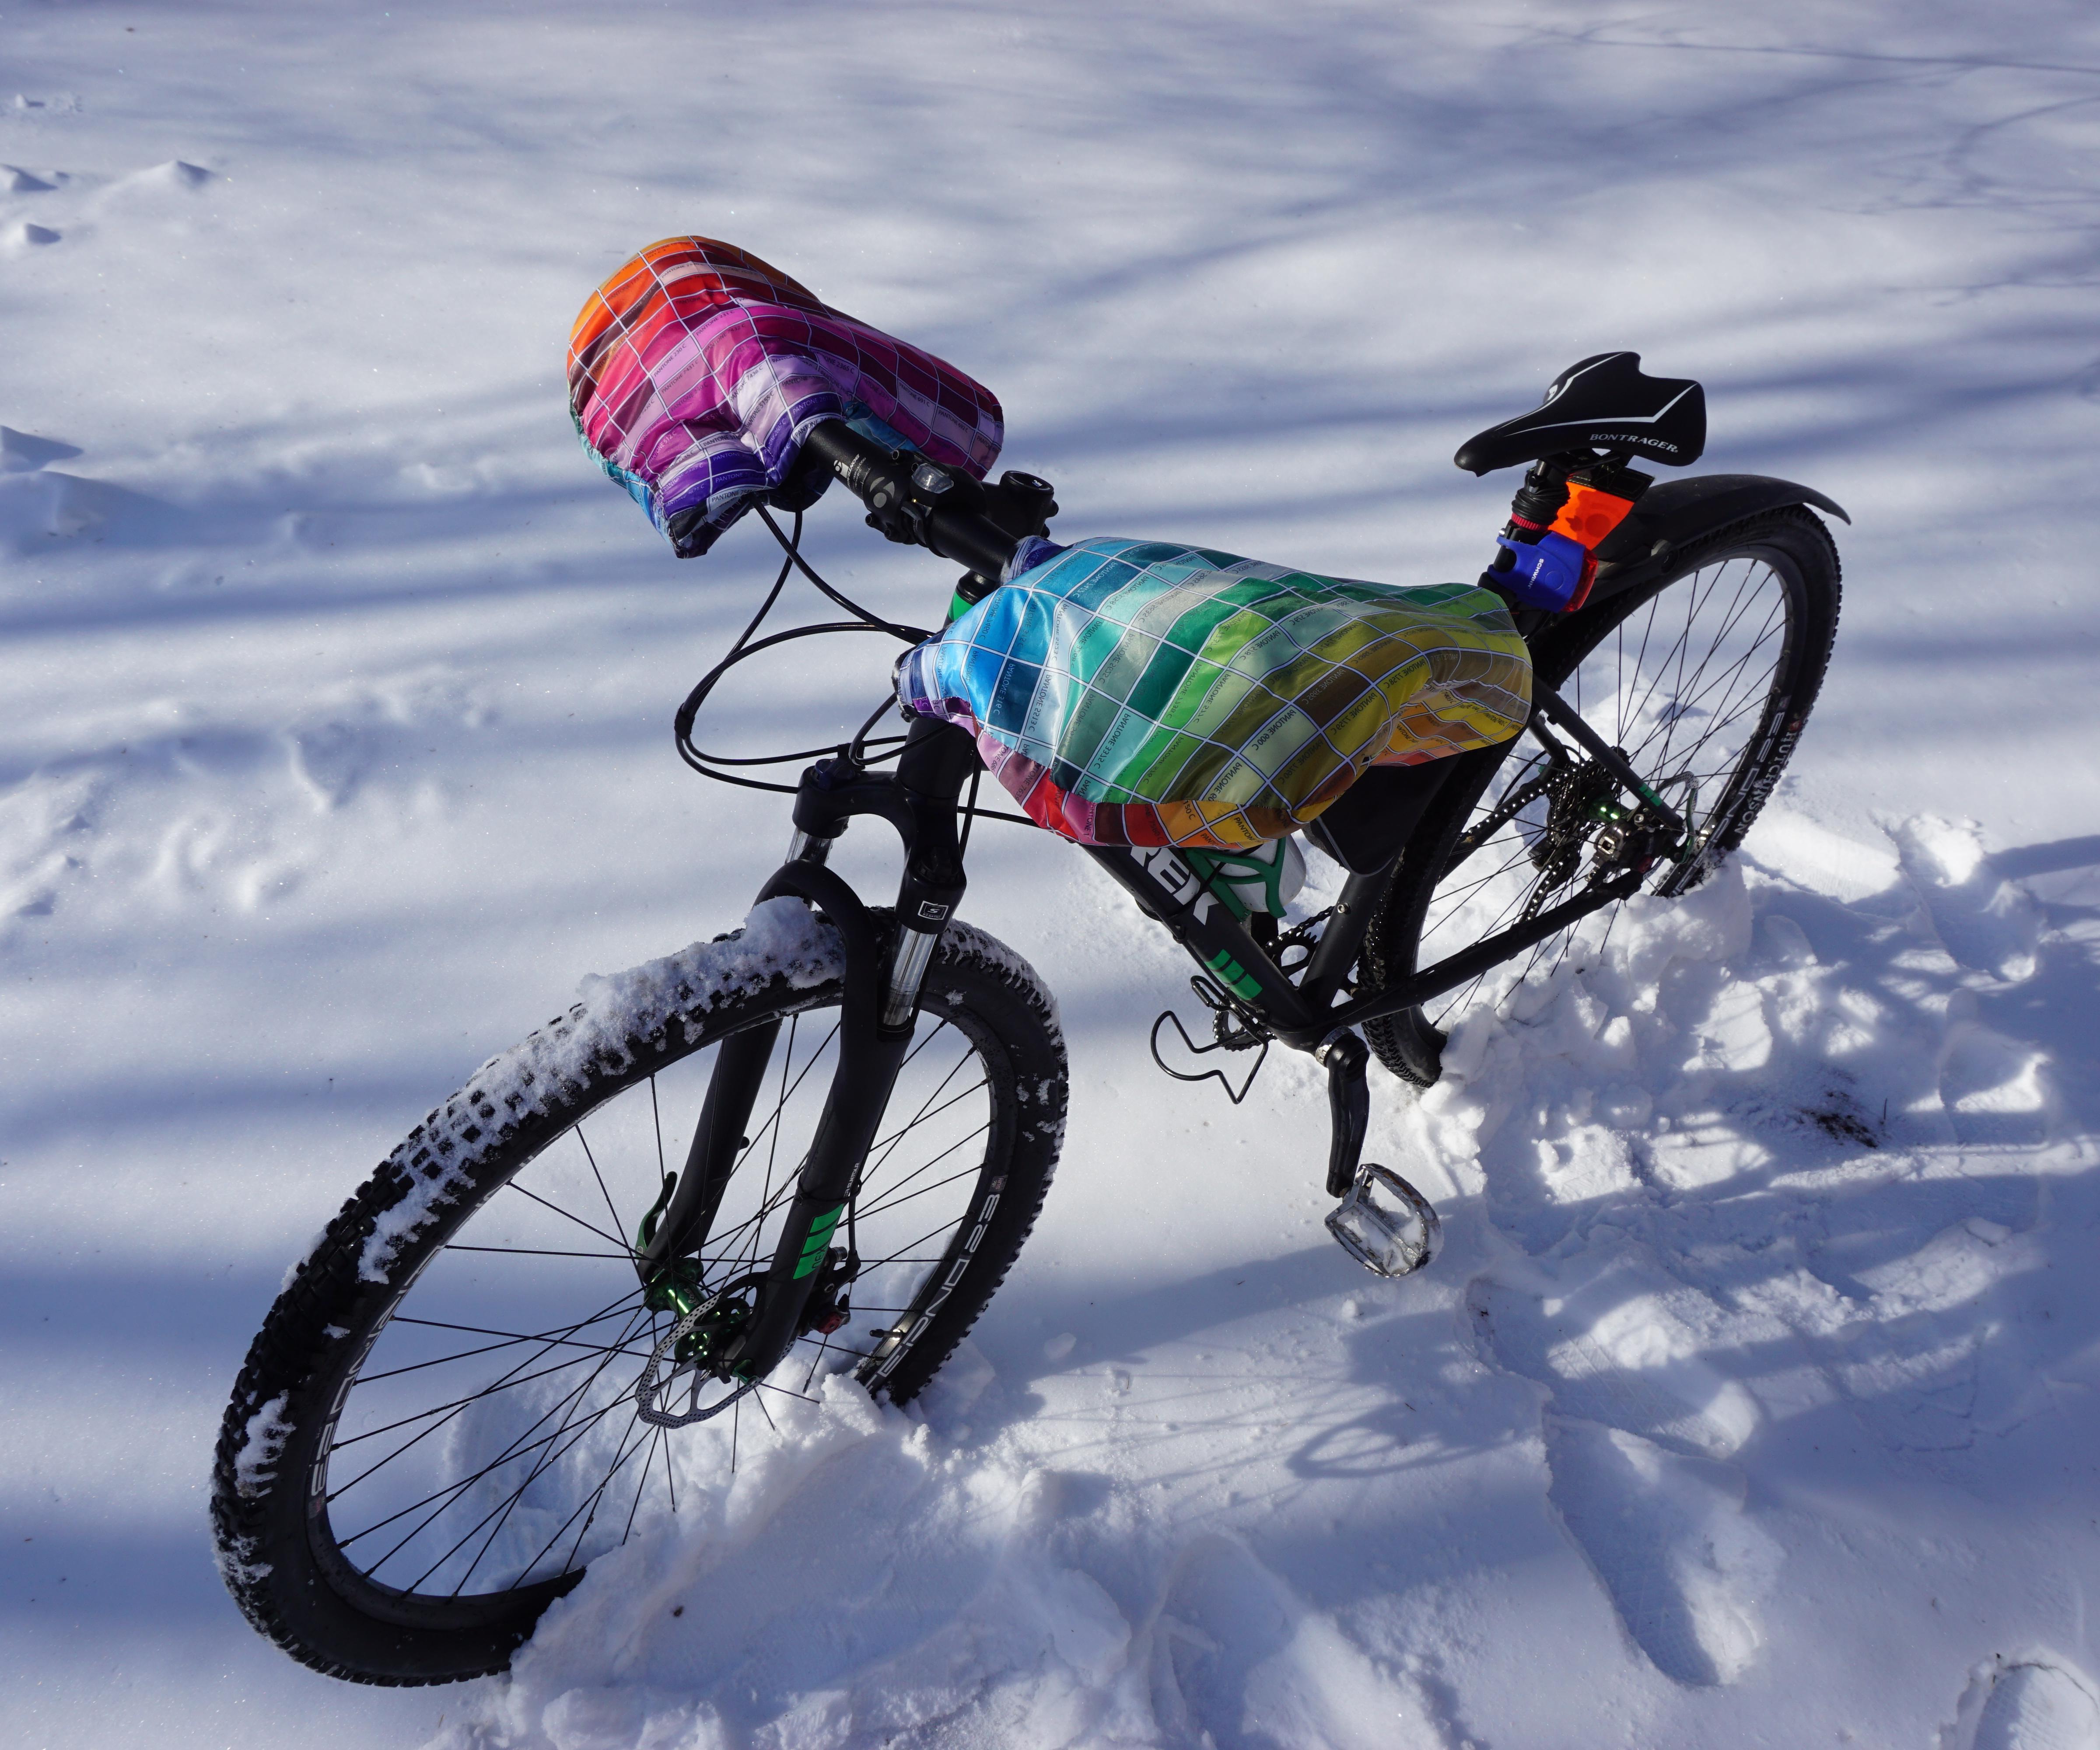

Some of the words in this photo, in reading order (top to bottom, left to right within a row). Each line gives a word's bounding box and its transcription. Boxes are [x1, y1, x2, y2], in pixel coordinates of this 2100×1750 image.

[696, 318, 719, 336] PANTONE
[705, 332, 727, 353] PANTONE
[654, 357, 674, 378] PANTONE
[673, 346, 683, 357] 230
[836, 361, 850, 371] 2365
[662, 374, 684, 394] PANTONE
[683, 363, 695, 375] 7431
[730, 380, 747, 402] PANTONE
[746, 370, 759, 382] 7436
[669, 392, 694, 412] PANTONE
[760, 396, 771, 410] 5155
[793, 399, 819, 415] PANTONE
[938, 410, 958, 425] PANTONE
[795, 419, 819, 438] PANTONE
[662, 434, 674, 447] 512
[703, 434, 729, 447] PANTONE
[1589, 433, 1678, 454] BONTRAGER
[715, 472, 743, 483] PANTONE
[711, 491, 740, 503] PANTONE
[1529, 558, 1544, 589] SCHWINN
[990, 760, 998, 771] 686
[1735, 731, 1796, 833] HUTCHINSON
[847, 1162, 860, 1189] SUNTOUR
[965, 1193, 1000, 1253] 23
